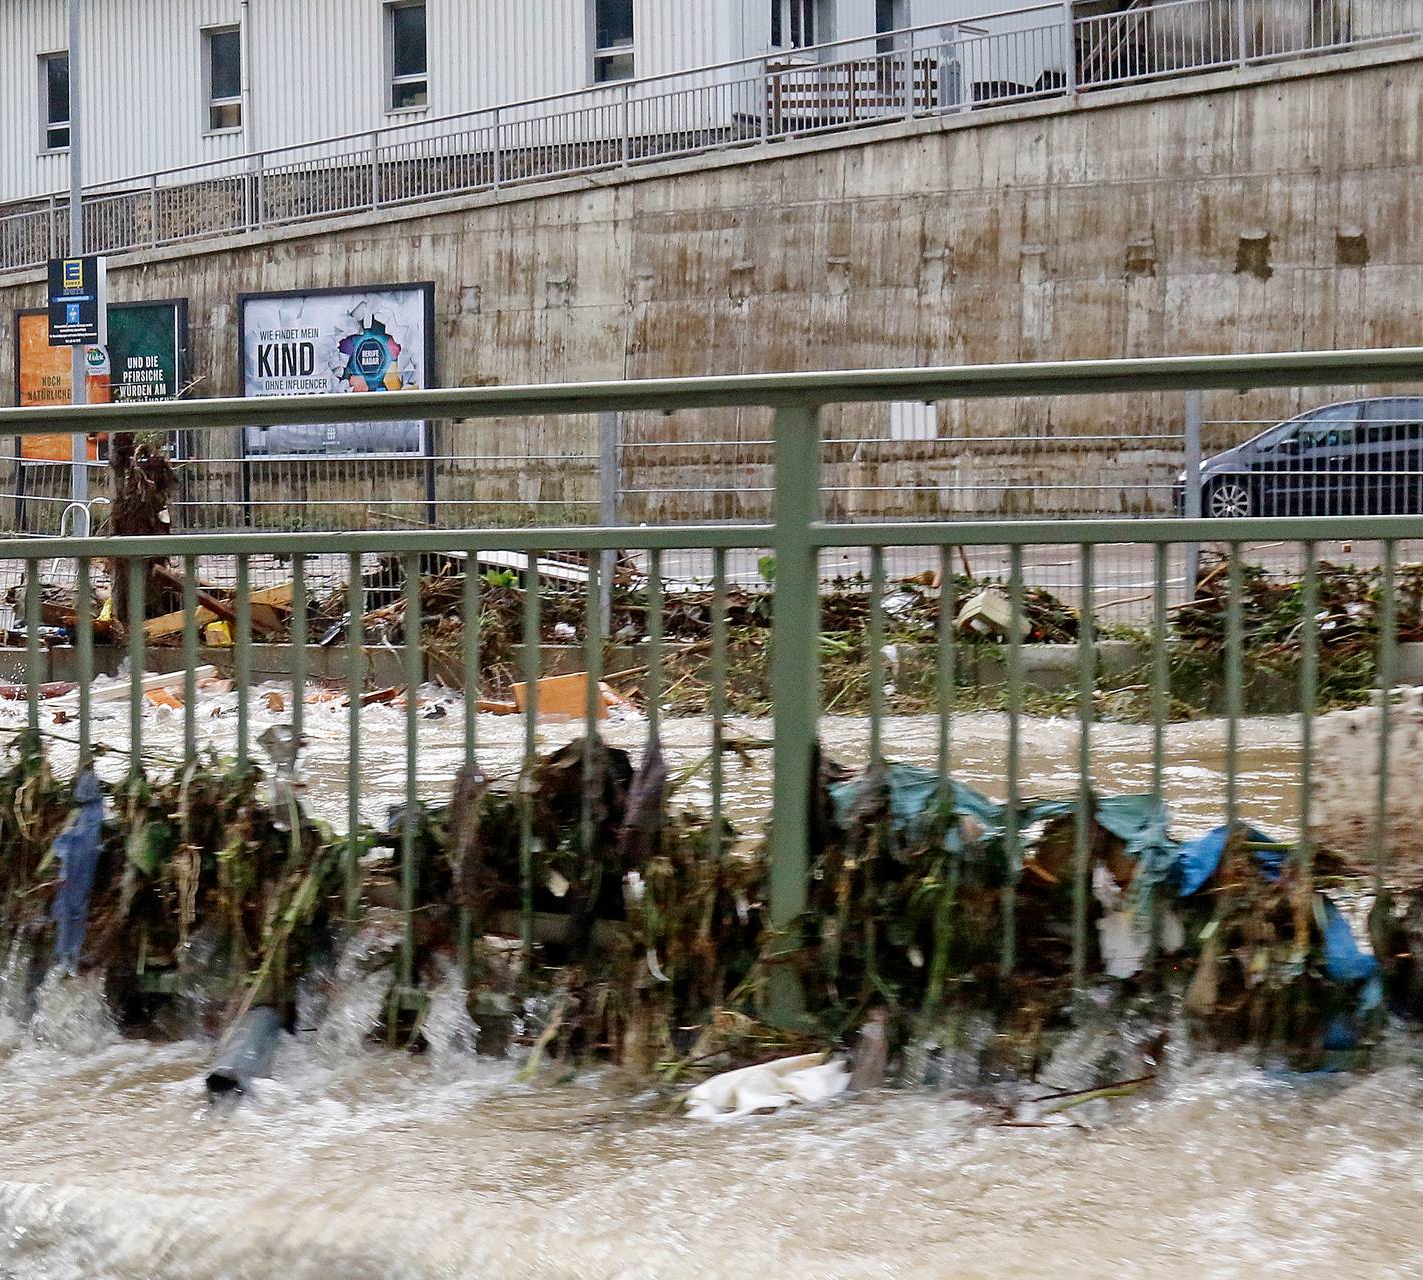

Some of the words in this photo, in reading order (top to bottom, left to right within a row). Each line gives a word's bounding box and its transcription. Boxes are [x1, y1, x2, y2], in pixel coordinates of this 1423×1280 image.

[260, 330, 273, 341] WIE
[275, 329, 299, 340] FINDET
[301, 328, 319, 338] MEIN
[127, 356, 143, 369] UND
[145, 355, 159, 368] DIE
[258, 342, 315, 378] KIND
[42, 376, 61, 387] NOCH
[123, 369, 164, 383] PFIRSICHE
[119, 383, 152, 397] WÜRDEN
[154, 384, 166, 396] AM
[265, 380, 284, 390] OHNE
[285, 379, 328, 390] INFLUENCER
